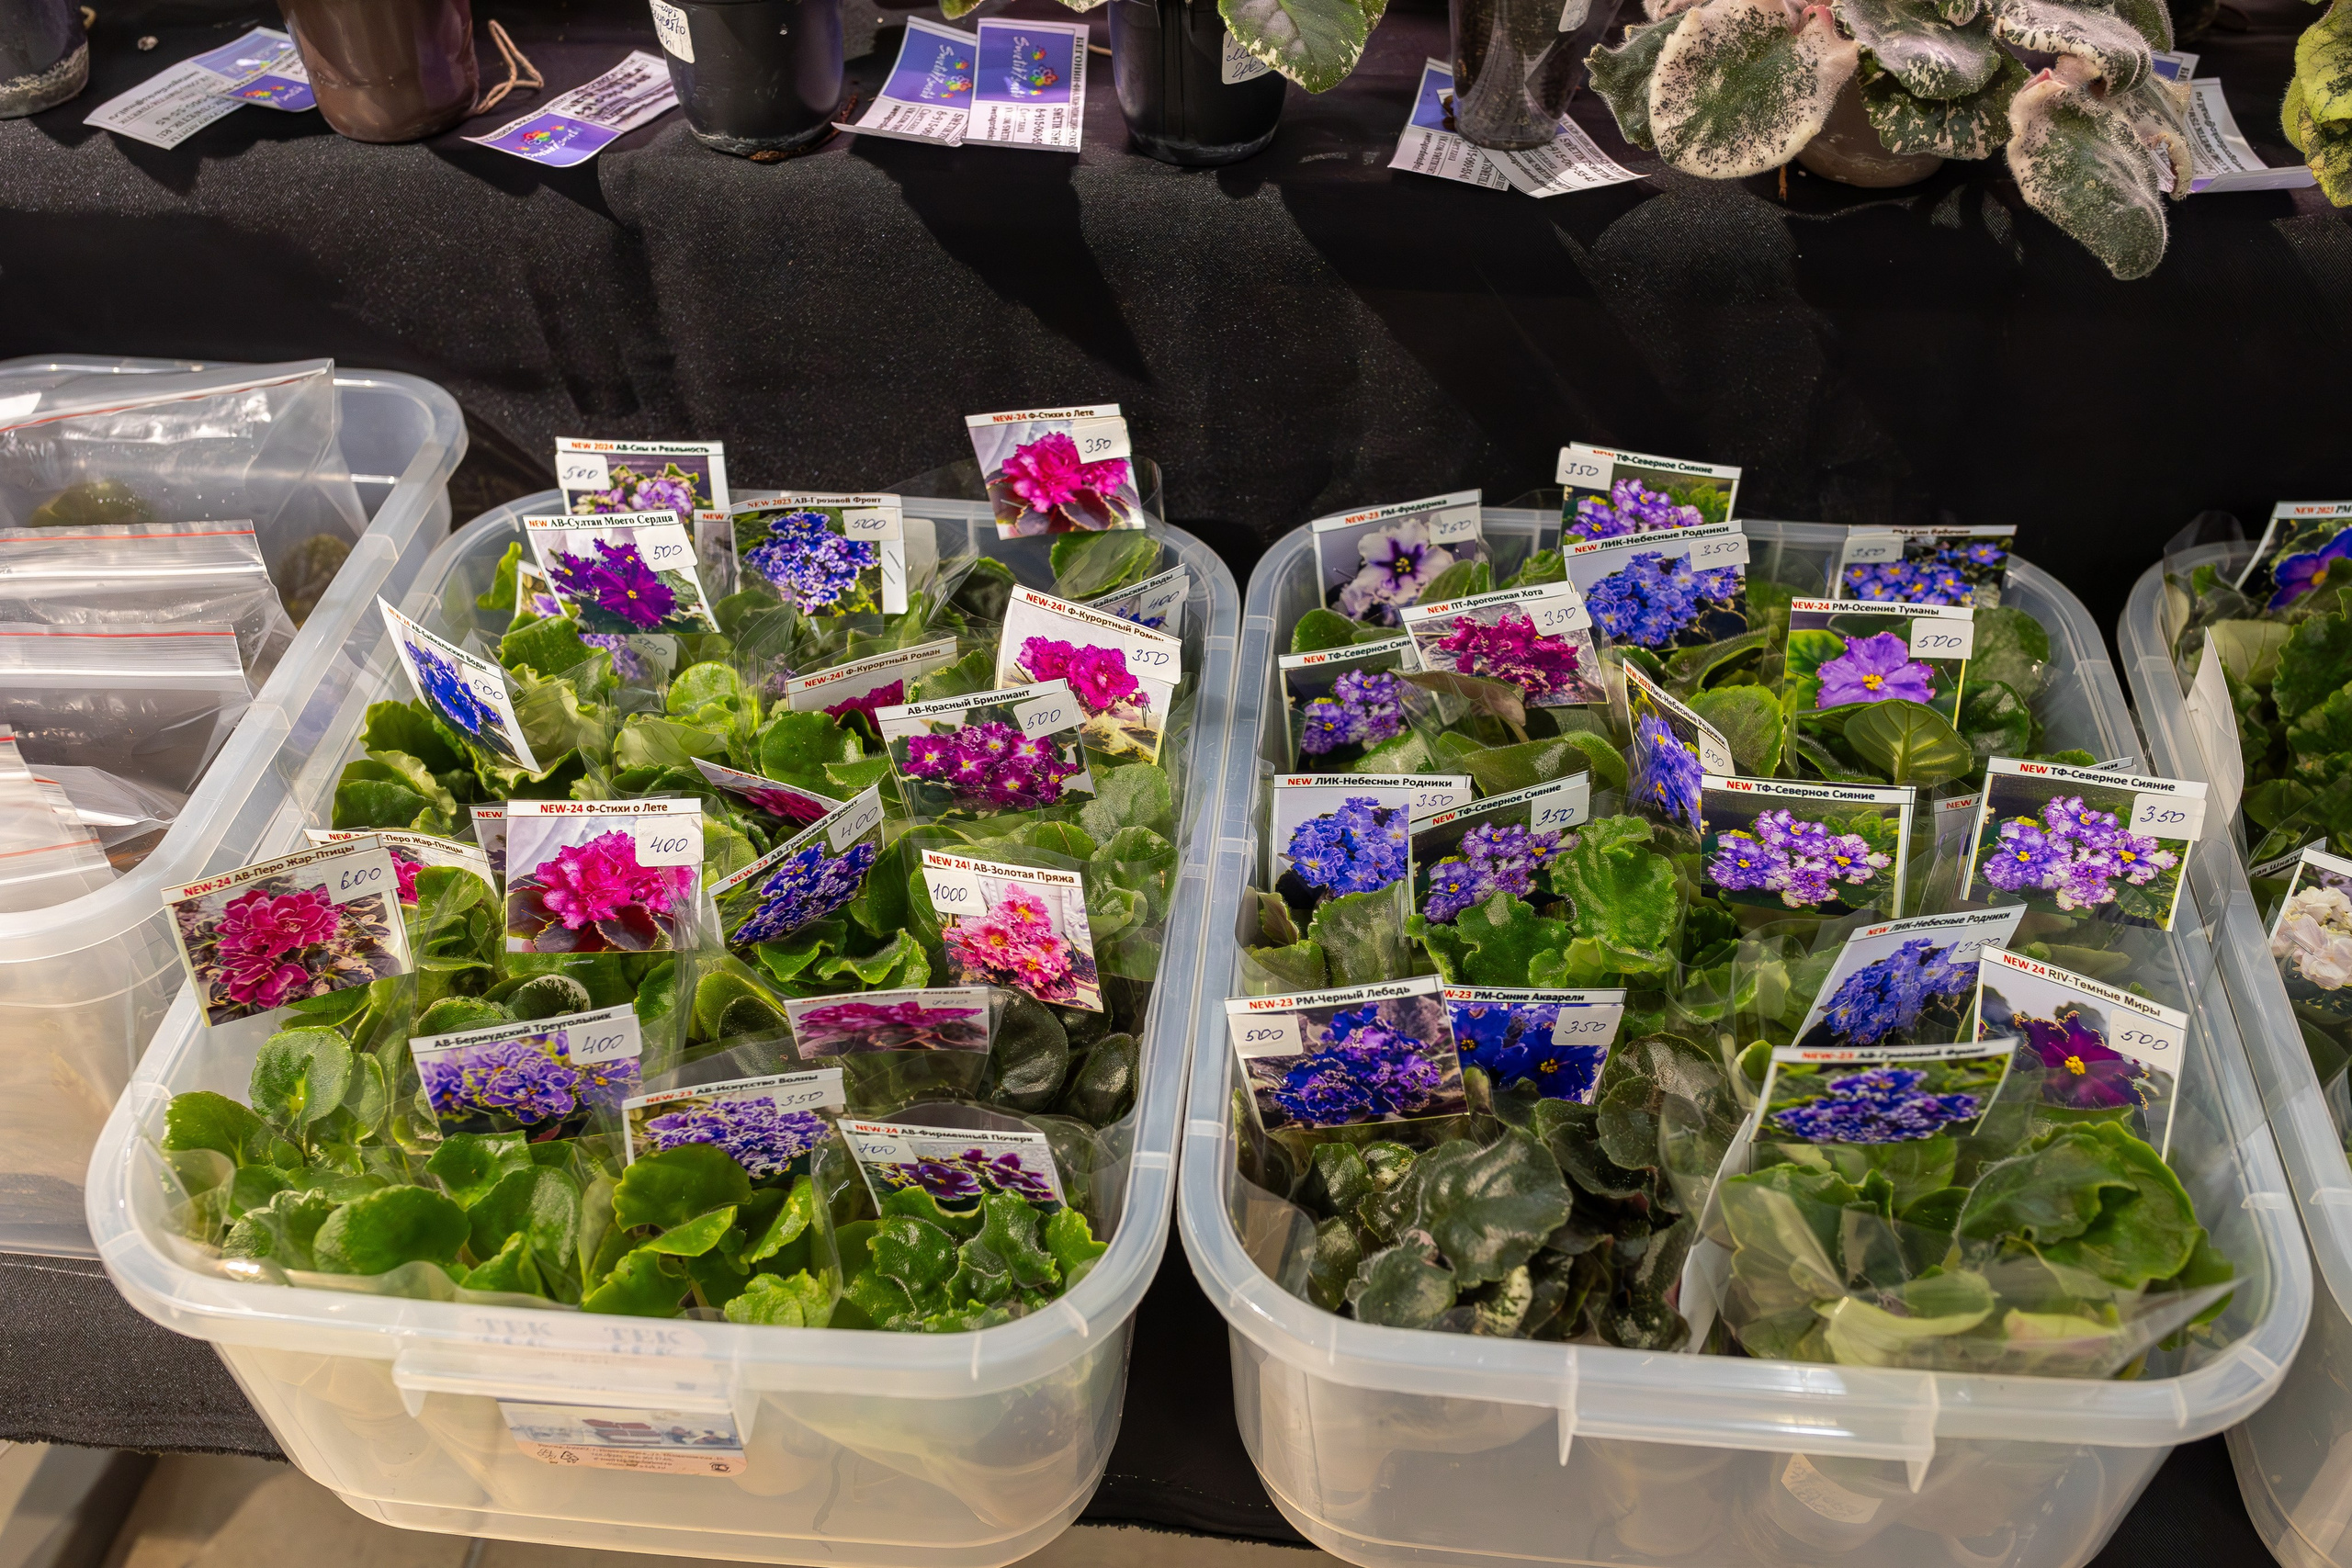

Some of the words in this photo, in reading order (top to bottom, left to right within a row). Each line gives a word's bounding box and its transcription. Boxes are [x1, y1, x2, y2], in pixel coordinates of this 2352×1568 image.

[992, 413, 1027, 423] NEW-24
[1028, 412, 1064, 420] Ф-Стихи
[1074, 409, 1094, 418] Лете
[571, 442, 592, 450] NEW
[1085, 438, 1112, 454] 350
[562, 466, 598, 480] 500
[1565, 462, 1599, 477] 350
[1615, 453, 1676, 469] ТФ-Северное
[1678, 461, 1713, 474] Сияние
[747, 502, 771, 510] NEW
[773, 498, 792, 507] 2023
[794, 496, 851, 505] АВ-Грозовой
[853, 496, 882, 504] Фронт
[2294, 506, 2314, 514] NEW
[528, 520, 548, 528] NEW
[550, 517, 603, 529] АВ-Султан
[605, 516, 635, 526] Моего
[636, 514, 673, 526] Сердца
[851, 518, 888, 531] 500
[1345, 511, 1379, 525] NEW-23
[1440, 519, 1472, 535] 350
[1575, 543, 1598, 553] NEW
[1600, 531, 1679, 549] ЛИК-Небесные
[1681, 525, 1729, 538] Родники
[652, 545, 683, 560] 500
[1701, 541, 1739, 557] 350
[1149, 574, 1174, 591] Воды
[1148, 591, 1181, 610] 400
[1427, 603, 1449, 615] NEW
[1450, 591, 1520, 610] ПТ-Арогонская
[1521, 587, 1544, 598] Хота
[1792, 601, 1830, 611] NEW-24
[1832, 603, 1896, 614] РМ-Осенние
[1898, 605, 1939, 615] Туманы
[1025, 592, 1066, 614] NEW-24!
[1067, 608, 1133, 634] Ф-Курортный
[1544, 606, 1577, 626] 350
[1917, 635, 1962, 649] 500
[466, 654, 488, 671] Воды
[1131, 649, 1170, 666] 350
[1303, 653, 1326, 664] NEW
[1328, 642, 1388, 660] ТФ-Северное
[804, 671, 844, 688] NEW-24!
[845, 655, 909, 676] Ф-Курортный
[910, 649, 941, 661] Роман
[473, 678, 504, 701] 500
[907, 697, 971, 716] АВ-Красный
[973, 688, 1031, 705] Бриллиант
[1026, 708, 1061, 729] 500
[1650, 684, 1698, 724] Лик-Небесные
[1697, 718, 1726, 747] Родники
[1704, 748, 1724, 768] 500
[1287, 777, 1312, 786] NEW
[1315, 776, 1400, 787] ЛИК-Небесные
[1402, 777, 1453, 788] Родники
[2019, 763, 2049, 774] NEW
[2051, 767, 2129, 785] ТФ-Северное
[2131, 778, 2176, 792] Сияние
[1726, 780, 1753, 791] NEW
[1755, 784, 1829, 798] ТФ-Северное
[1832, 790, 1875, 801] Сияние
[540, 805, 583, 814] NEW-24
[586, 804, 630, 814] Ф-Стихи
[642, 803, 668, 813] Лете
[1416, 794, 1454, 807] 350
[1432, 812, 1456, 826] NEW
[1457, 795, 1523, 817] ТФ-Северное
[1524, 784, 1562, 799] Сияние
[1946, 798, 1973, 810] NEW
[840, 807, 878, 839] 400
[1535, 807, 1576, 828] 350
[2140, 806, 2186, 823] 350
[412, 838, 464, 854] Жар-Птицы
[650, 836, 688, 853] 400
[729, 860, 769, 886] NEW-23
[770, 820, 829, 862] АВ-Грозовой
[829, 799, 859, 821] Фронт
[184, 877, 232, 897] NEW-24
[234, 862, 284, 884] АВ-Перо
[286, 844, 356, 868] Жар-Птицы
[928, 853, 952, 867] NEW
[954, 859, 971, 871] 24!
[973, 863, 1035, 881] АВ-Золотая
[1037, 871, 1075, 885] Пряжа
[340, 867, 382, 891] 600
[933, 883, 967, 903] 1000
[1866, 926, 1890, 936] NEW
[1889, 917, 1965, 932] ЛИК-Небесные
[1967, 911, 2011, 925] Родники
[2003, 954, 2030, 970] NEW
[2032, 964, 2045, 976] 24
[2048, 969, 2121, 1001] RIV-Темные
[2124, 995, 2161, 1017] Миры
[1250, 998, 1294, 1010] NEW-23
[1295, 991, 1364, 1006] РМ-Черный
[1366, 986, 1410, 998] Лебедь
[1443, 989, 1472, 999] W-23
[1474, 991, 1529, 1001] РМ-Синие
[1531, 993, 1585, 1003] Акварели
[434, 1027, 531, 1048] АВ-Бермудский
[534, 1011, 611, 1033] Треугольник
[1245, 1028, 1283, 1042] 500
[1564, 1021, 1607, 1034] 350
[582, 1033, 625, 1055] 400
[2120, 1030, 2169, 1051] 500
[646, 1090, 693, 1104] NEW-23
[695, 1078, 775, 1095] АВ-Искусство
[778, 1073, 819, 1084] Волны
[781, 1090, 824, 1107] 350
[855, 1123, 899, 1134] NEW-24
[900, 1127, 989, 1141] АВ-Фирменный
[991, 1134, 1034, 1144] Почерк
